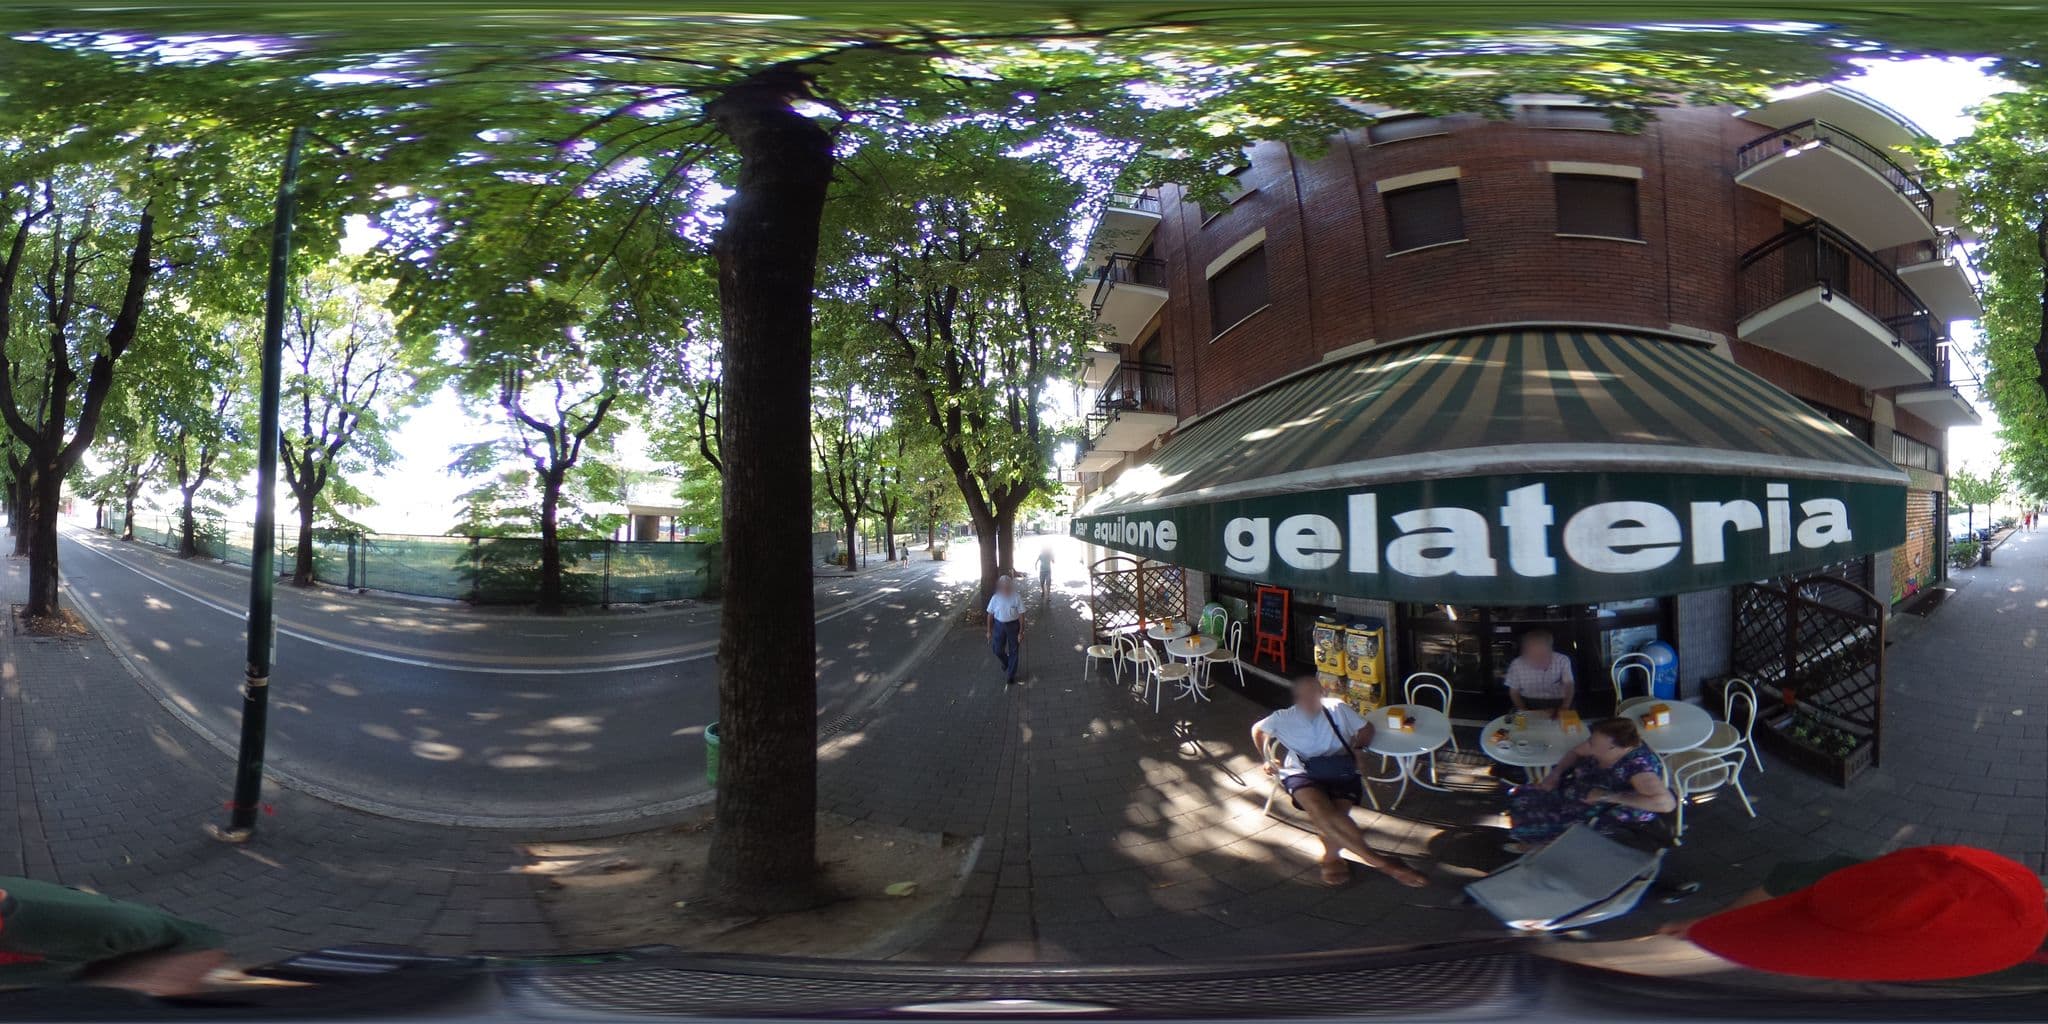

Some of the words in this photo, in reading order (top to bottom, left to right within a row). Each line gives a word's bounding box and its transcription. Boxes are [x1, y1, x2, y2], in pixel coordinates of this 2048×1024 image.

[1075, 519, 1088, 536] bar
[1094, 516, 1178, 551] aquilone
[1223, 483, 1852, 578] gelateria
